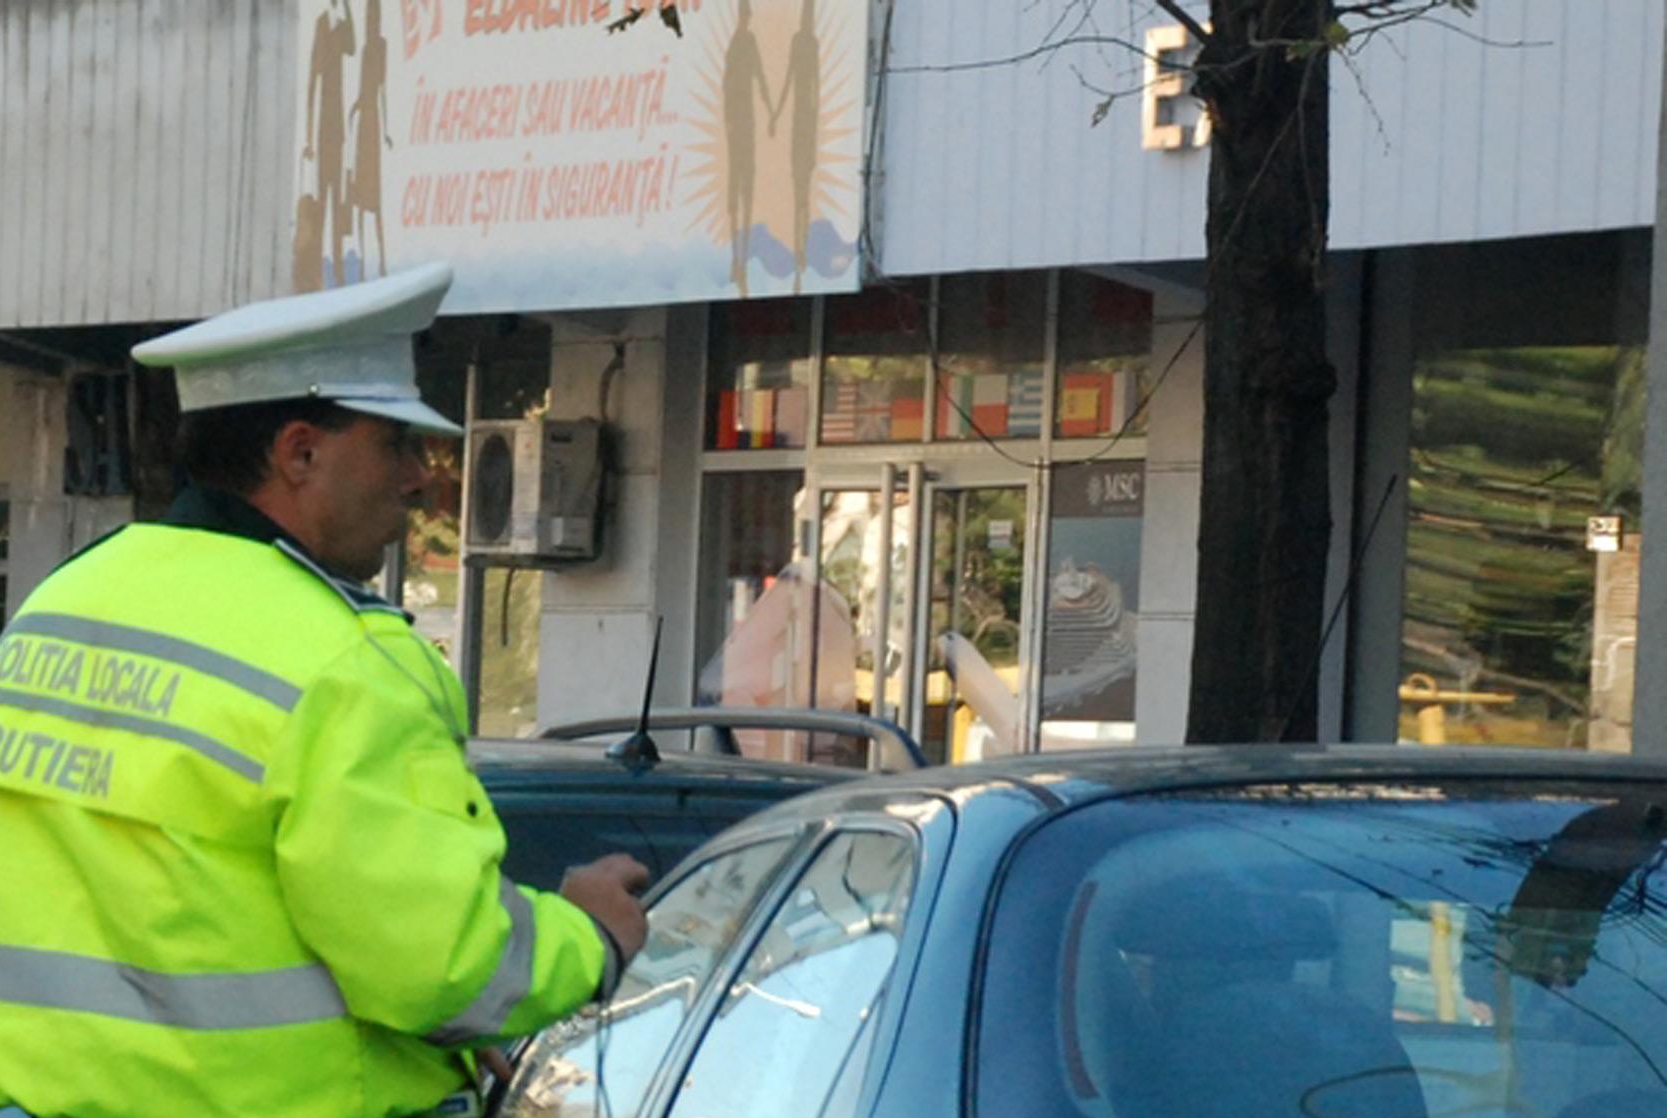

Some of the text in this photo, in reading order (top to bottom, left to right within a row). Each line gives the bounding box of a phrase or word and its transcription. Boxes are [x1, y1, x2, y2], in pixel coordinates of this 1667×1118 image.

[435, 84, 522, 143] AFACERI
[521, 78, 569, 137] SAU
[401, 174, 432, 227] CU
[431, 171, 471, 226] NOI
[1104, 473, 1141, 502] MSC
[87, 654, 185, 719] LOCALA
